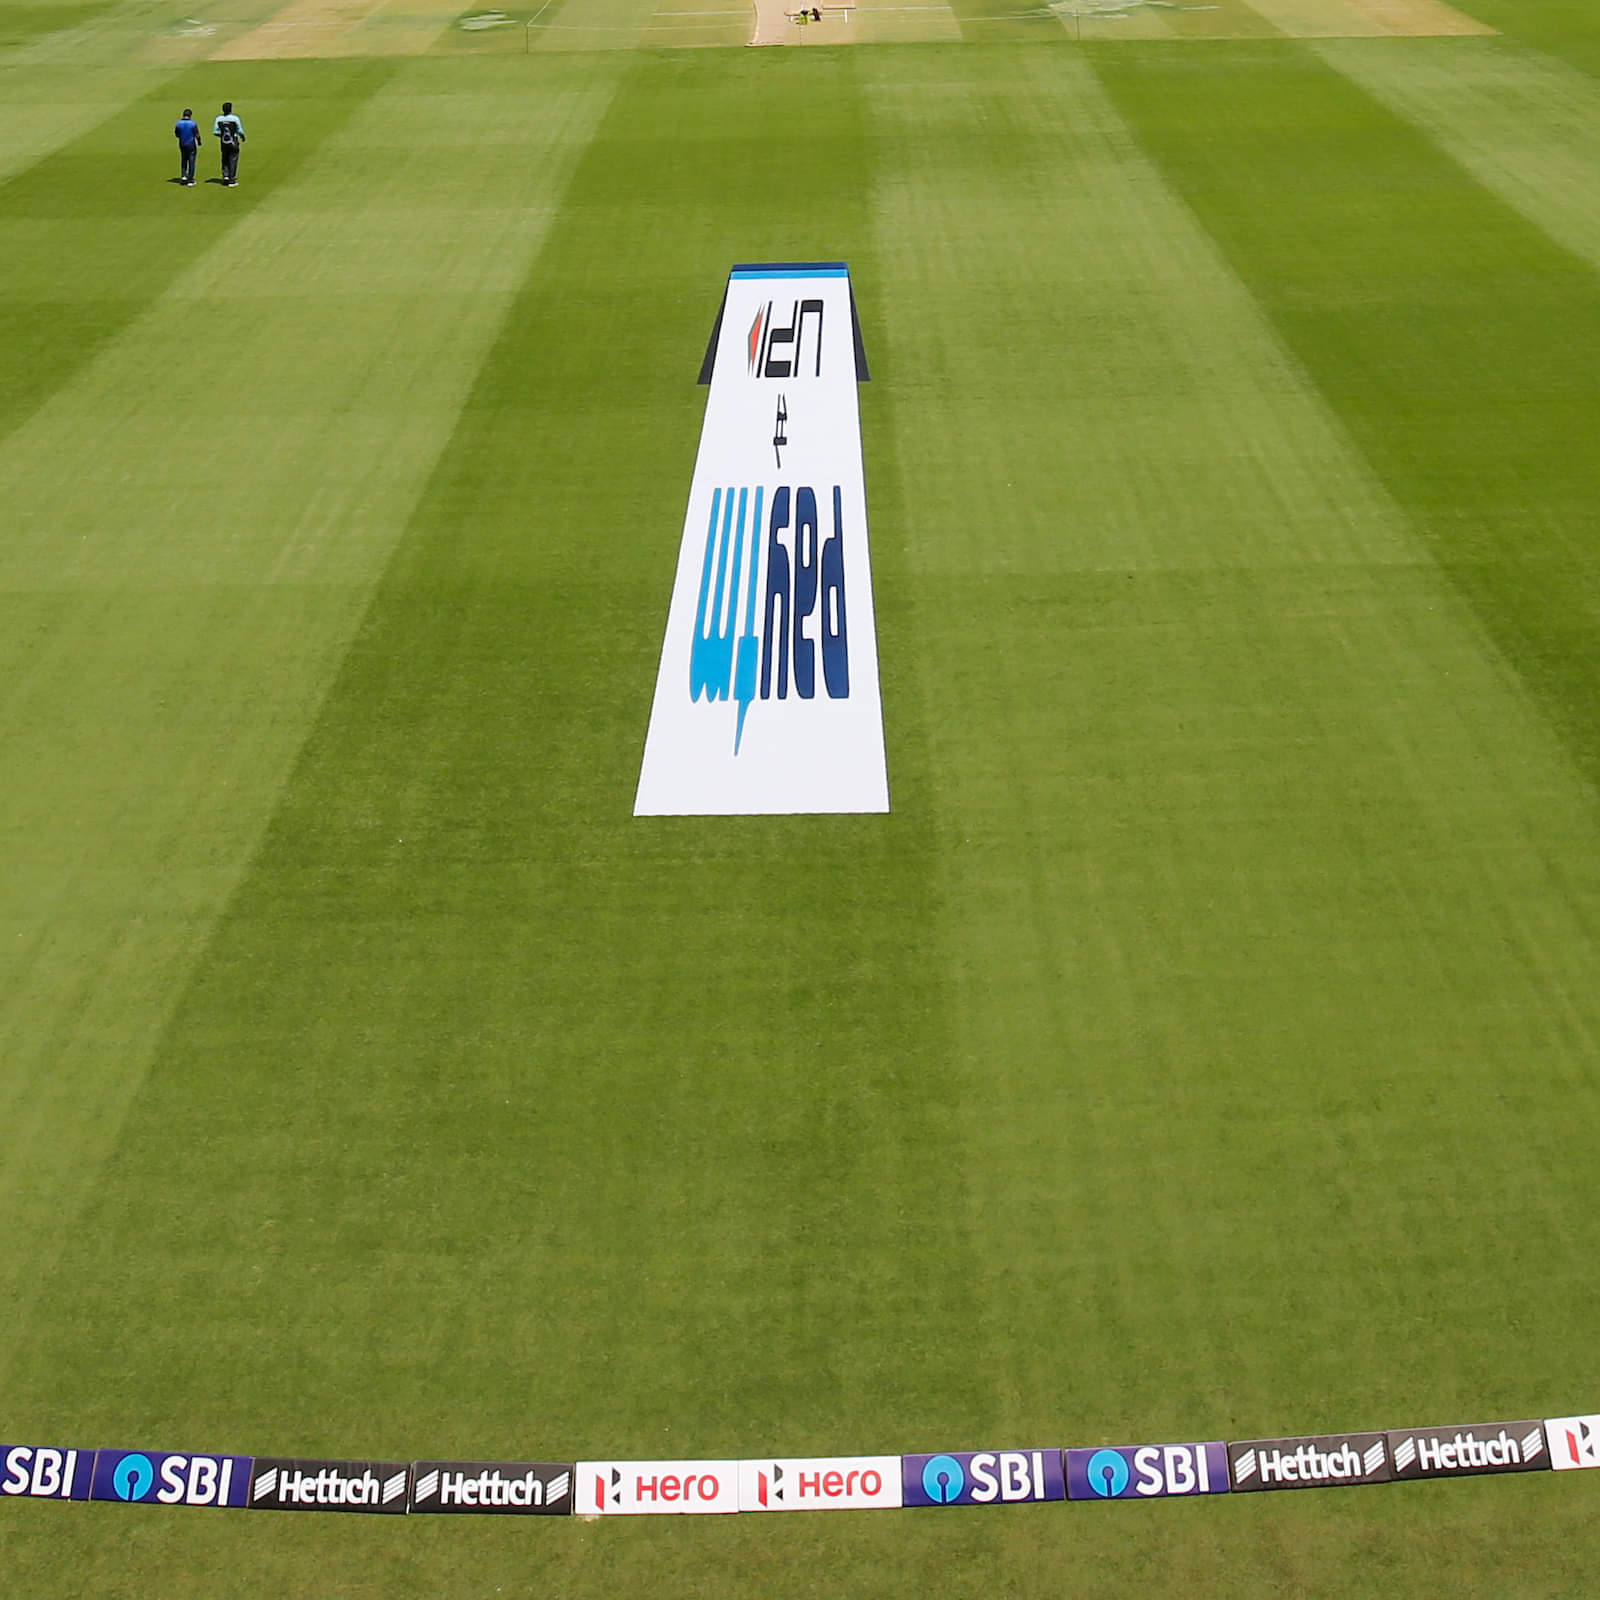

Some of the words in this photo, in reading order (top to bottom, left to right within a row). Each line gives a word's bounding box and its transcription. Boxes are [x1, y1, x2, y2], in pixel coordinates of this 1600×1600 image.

[756, 298, 824, 379] UPI
[688, 485, 850, 756] paytm
[1, 1445, 77, 1498] SBI
[1134, 1444, 1211, 1497] SBI
[1258, 1438, 1363, 1484] Hettich
[1417, 1429, 1522, 1471] Hettich
[155, 1454, 235, 1506] SBI
[278, 1467, 381, 1507] Hettich
[440, 1469, 545, 1508] Hettich
[635, 1474, 721, 1502] Hero
[798, 1467, 884, 1501] Hero
[970, 1451, 1046, 1503] SBI
